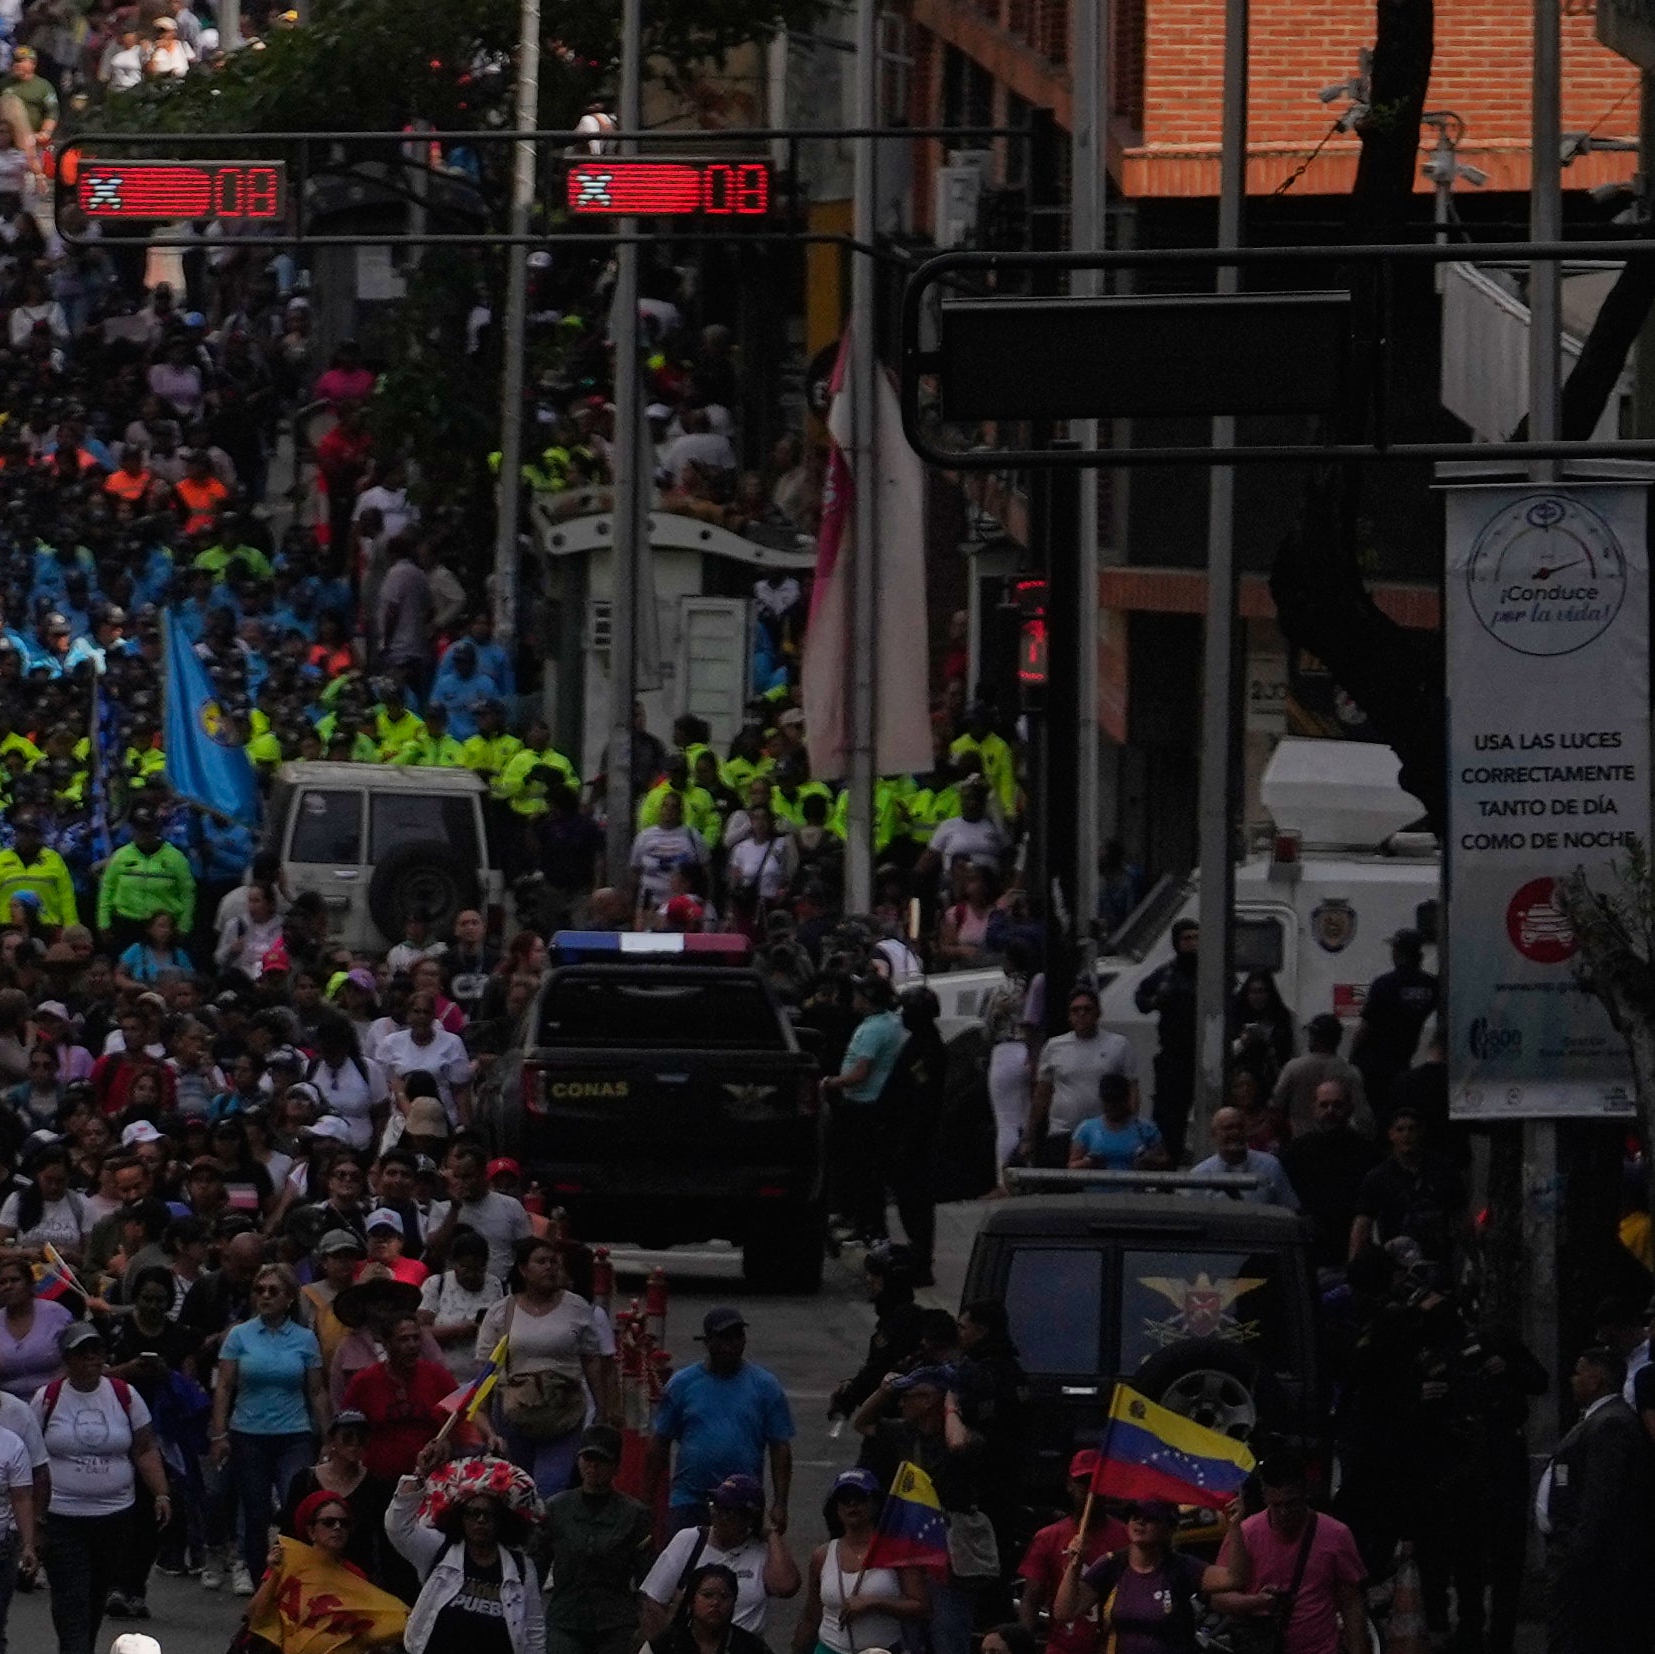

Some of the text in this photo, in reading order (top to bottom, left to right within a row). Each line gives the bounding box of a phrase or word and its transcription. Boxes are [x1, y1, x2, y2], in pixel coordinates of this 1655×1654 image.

[215, 167, 277, 216] 08
[703, 164, 768, 214] 08
[1501, 586, 1598, 606] ¡Conduce
[1531, 604, 1550, 623] la
[1475, 731, 1623, 751] USA LAS LUCES
[1462, 764, 1635, 783] CORRECTAMENTE
[1479, 793, 1618, 817] TANTO DE DÍA
[1462, 831, 1635, 850] COMO DE NOCHE
[551, 1082, 629, 1099] CONAS
